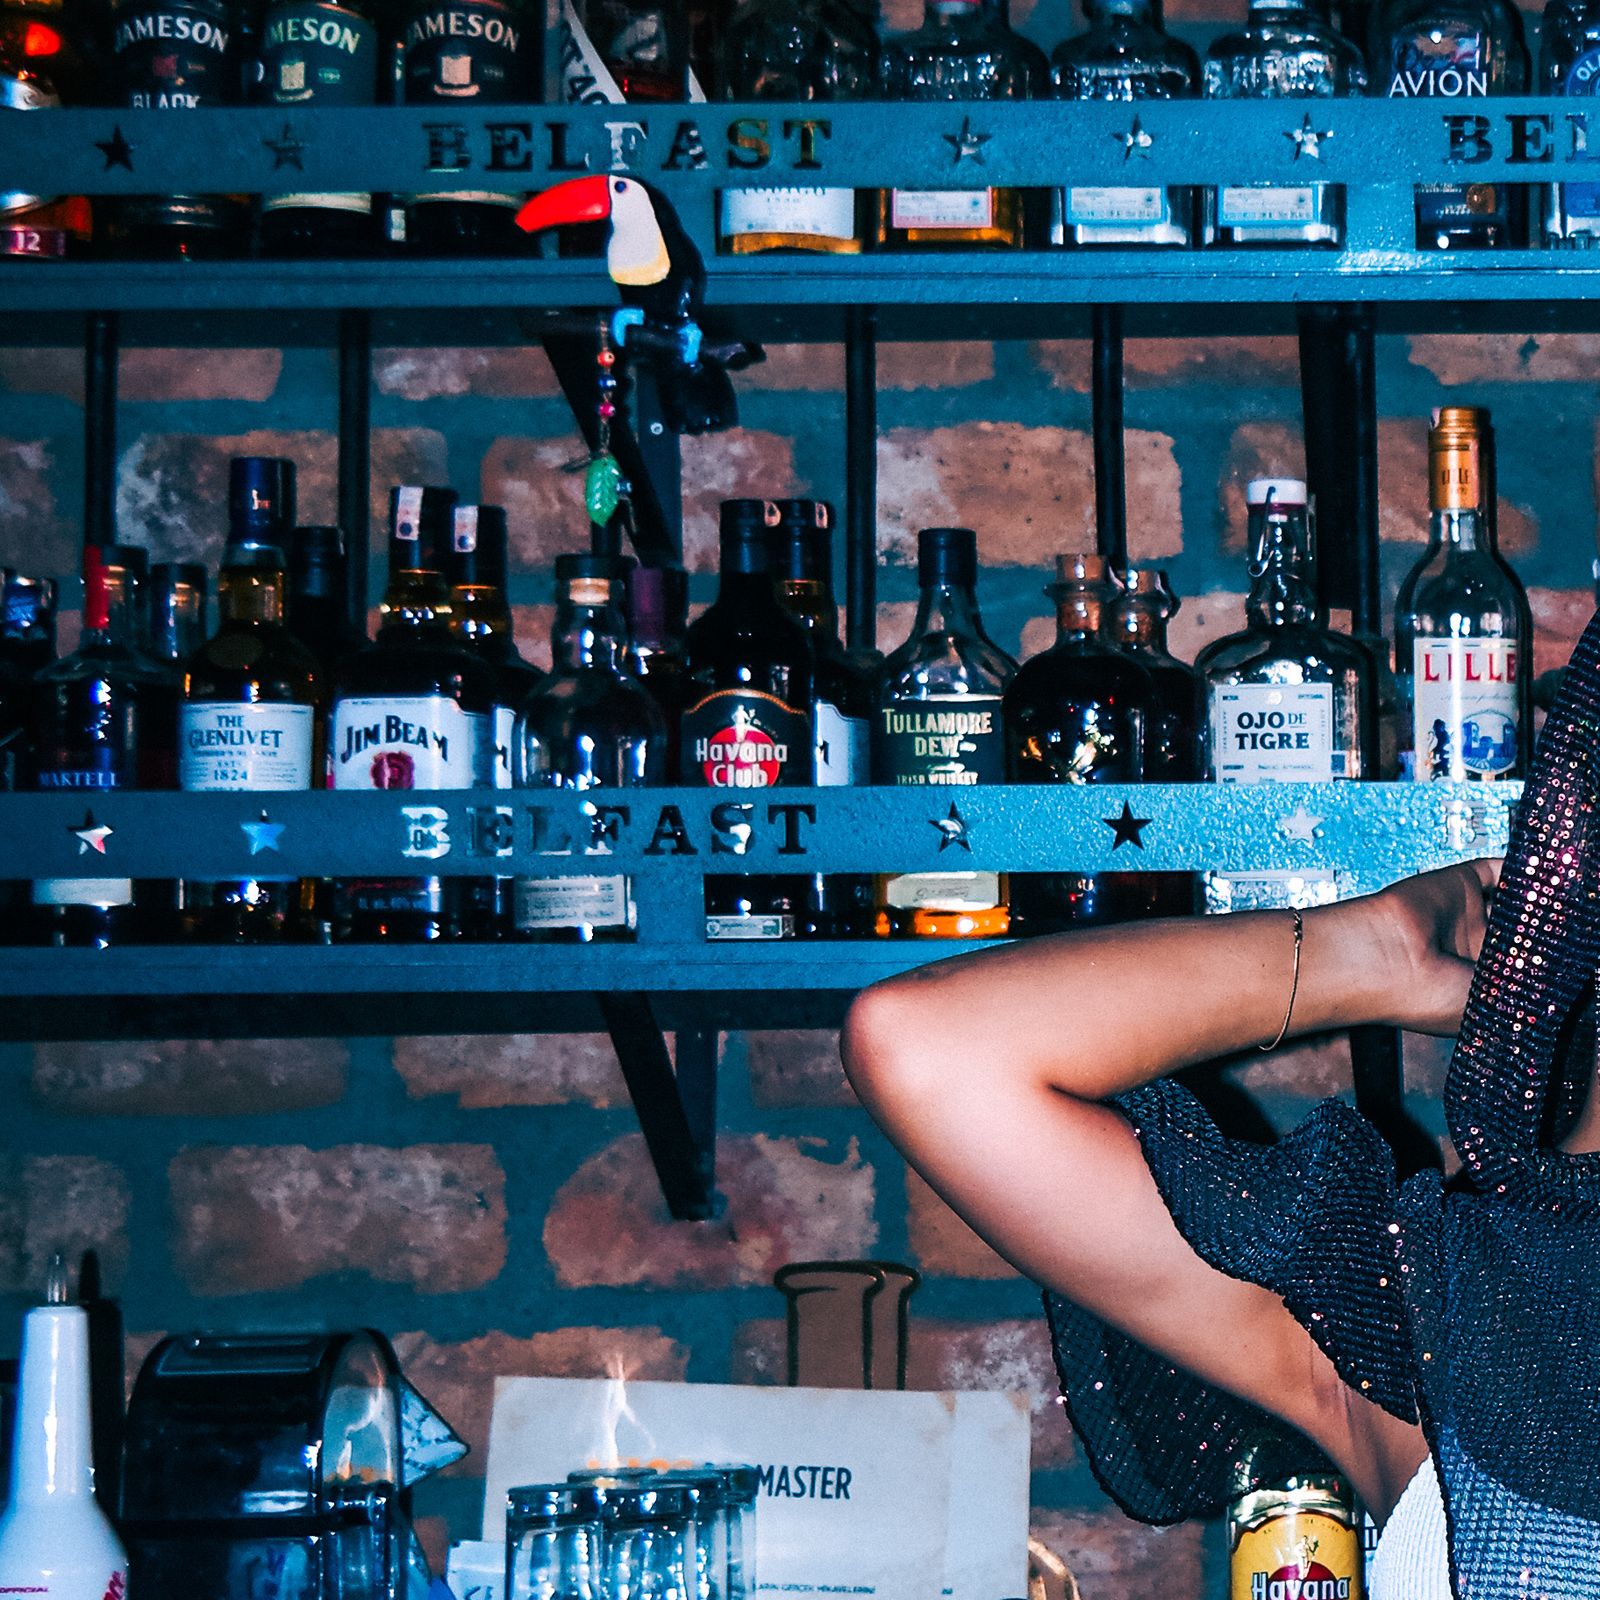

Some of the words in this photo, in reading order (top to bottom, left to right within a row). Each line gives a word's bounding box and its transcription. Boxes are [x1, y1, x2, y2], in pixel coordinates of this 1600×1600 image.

[422, 118, 833, 174] BELFAST
[17, 231, 41, 252] 12
[217, 715, 245, 728] THE
[881, 708, 993, 735] TULLAMORE
[1236, 711, 1286, 730] OJO
[1287, 712, 1308, 726] DE
[190, 729, 284, 749] GLENLIVET
[340, 725, 381, 763] JIM
[384, 714, 450, 760] BEAM
[696, 736, 788, 763] Havana
[914, 734, 964, 758] DEW
[1234, 732, 1310, 750] TIGRE
[39, 770, 120, 788] MARTELL
[214, 769, 248, 781] 1824
[712, 761, 770, 787] Club
[401, 803, 817, 859] BELFAST
[756, 1463, 853, 1501] MASTER
